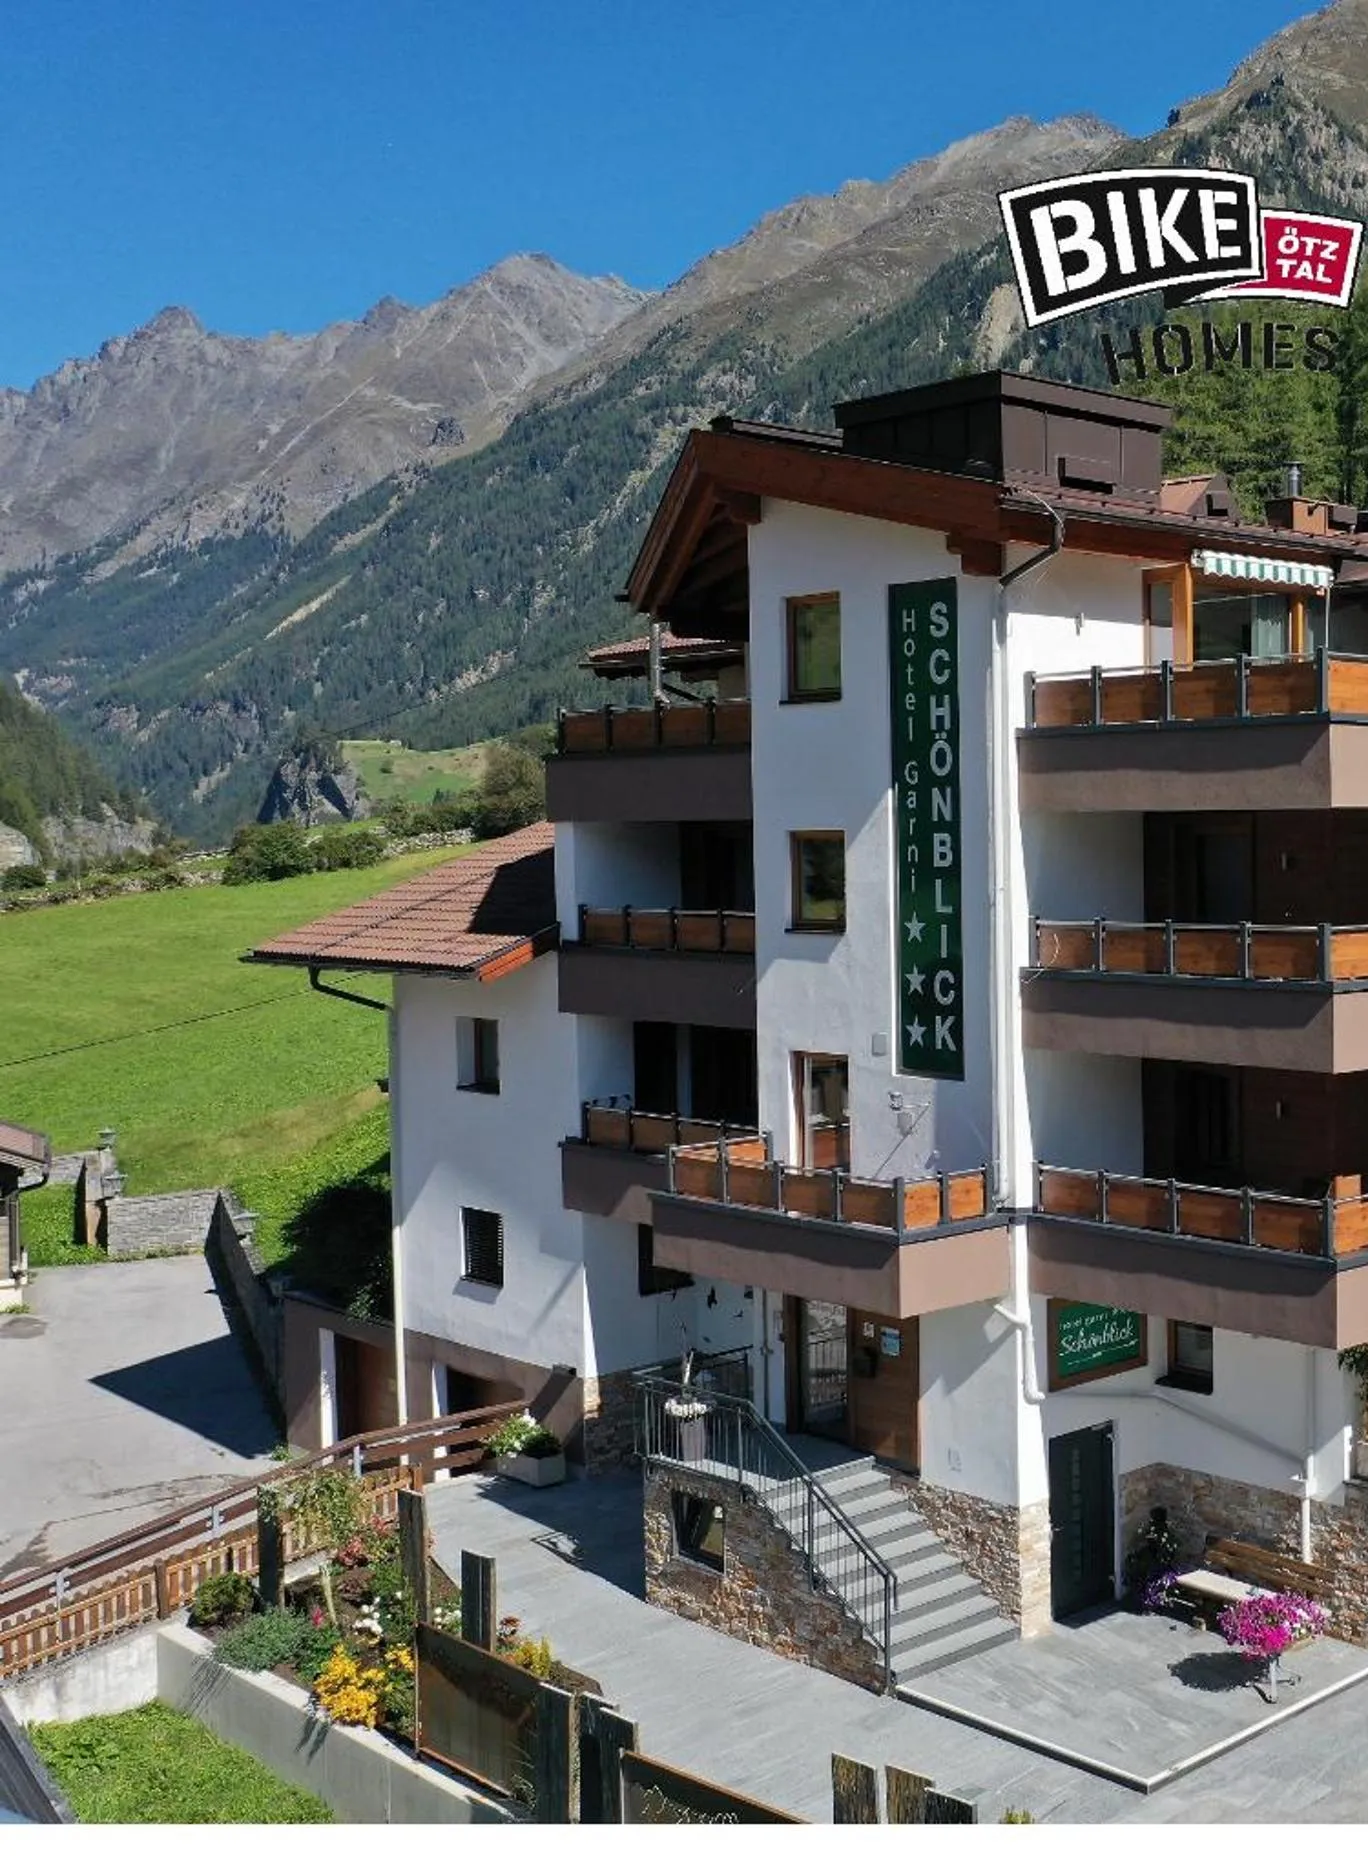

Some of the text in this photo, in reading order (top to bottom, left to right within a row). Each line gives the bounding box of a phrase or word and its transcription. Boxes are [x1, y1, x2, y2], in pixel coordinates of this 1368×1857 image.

[902, 608, 919, 893] Hotel Garni
[929, 601, 957, 1052] SCHÖNBLICK
